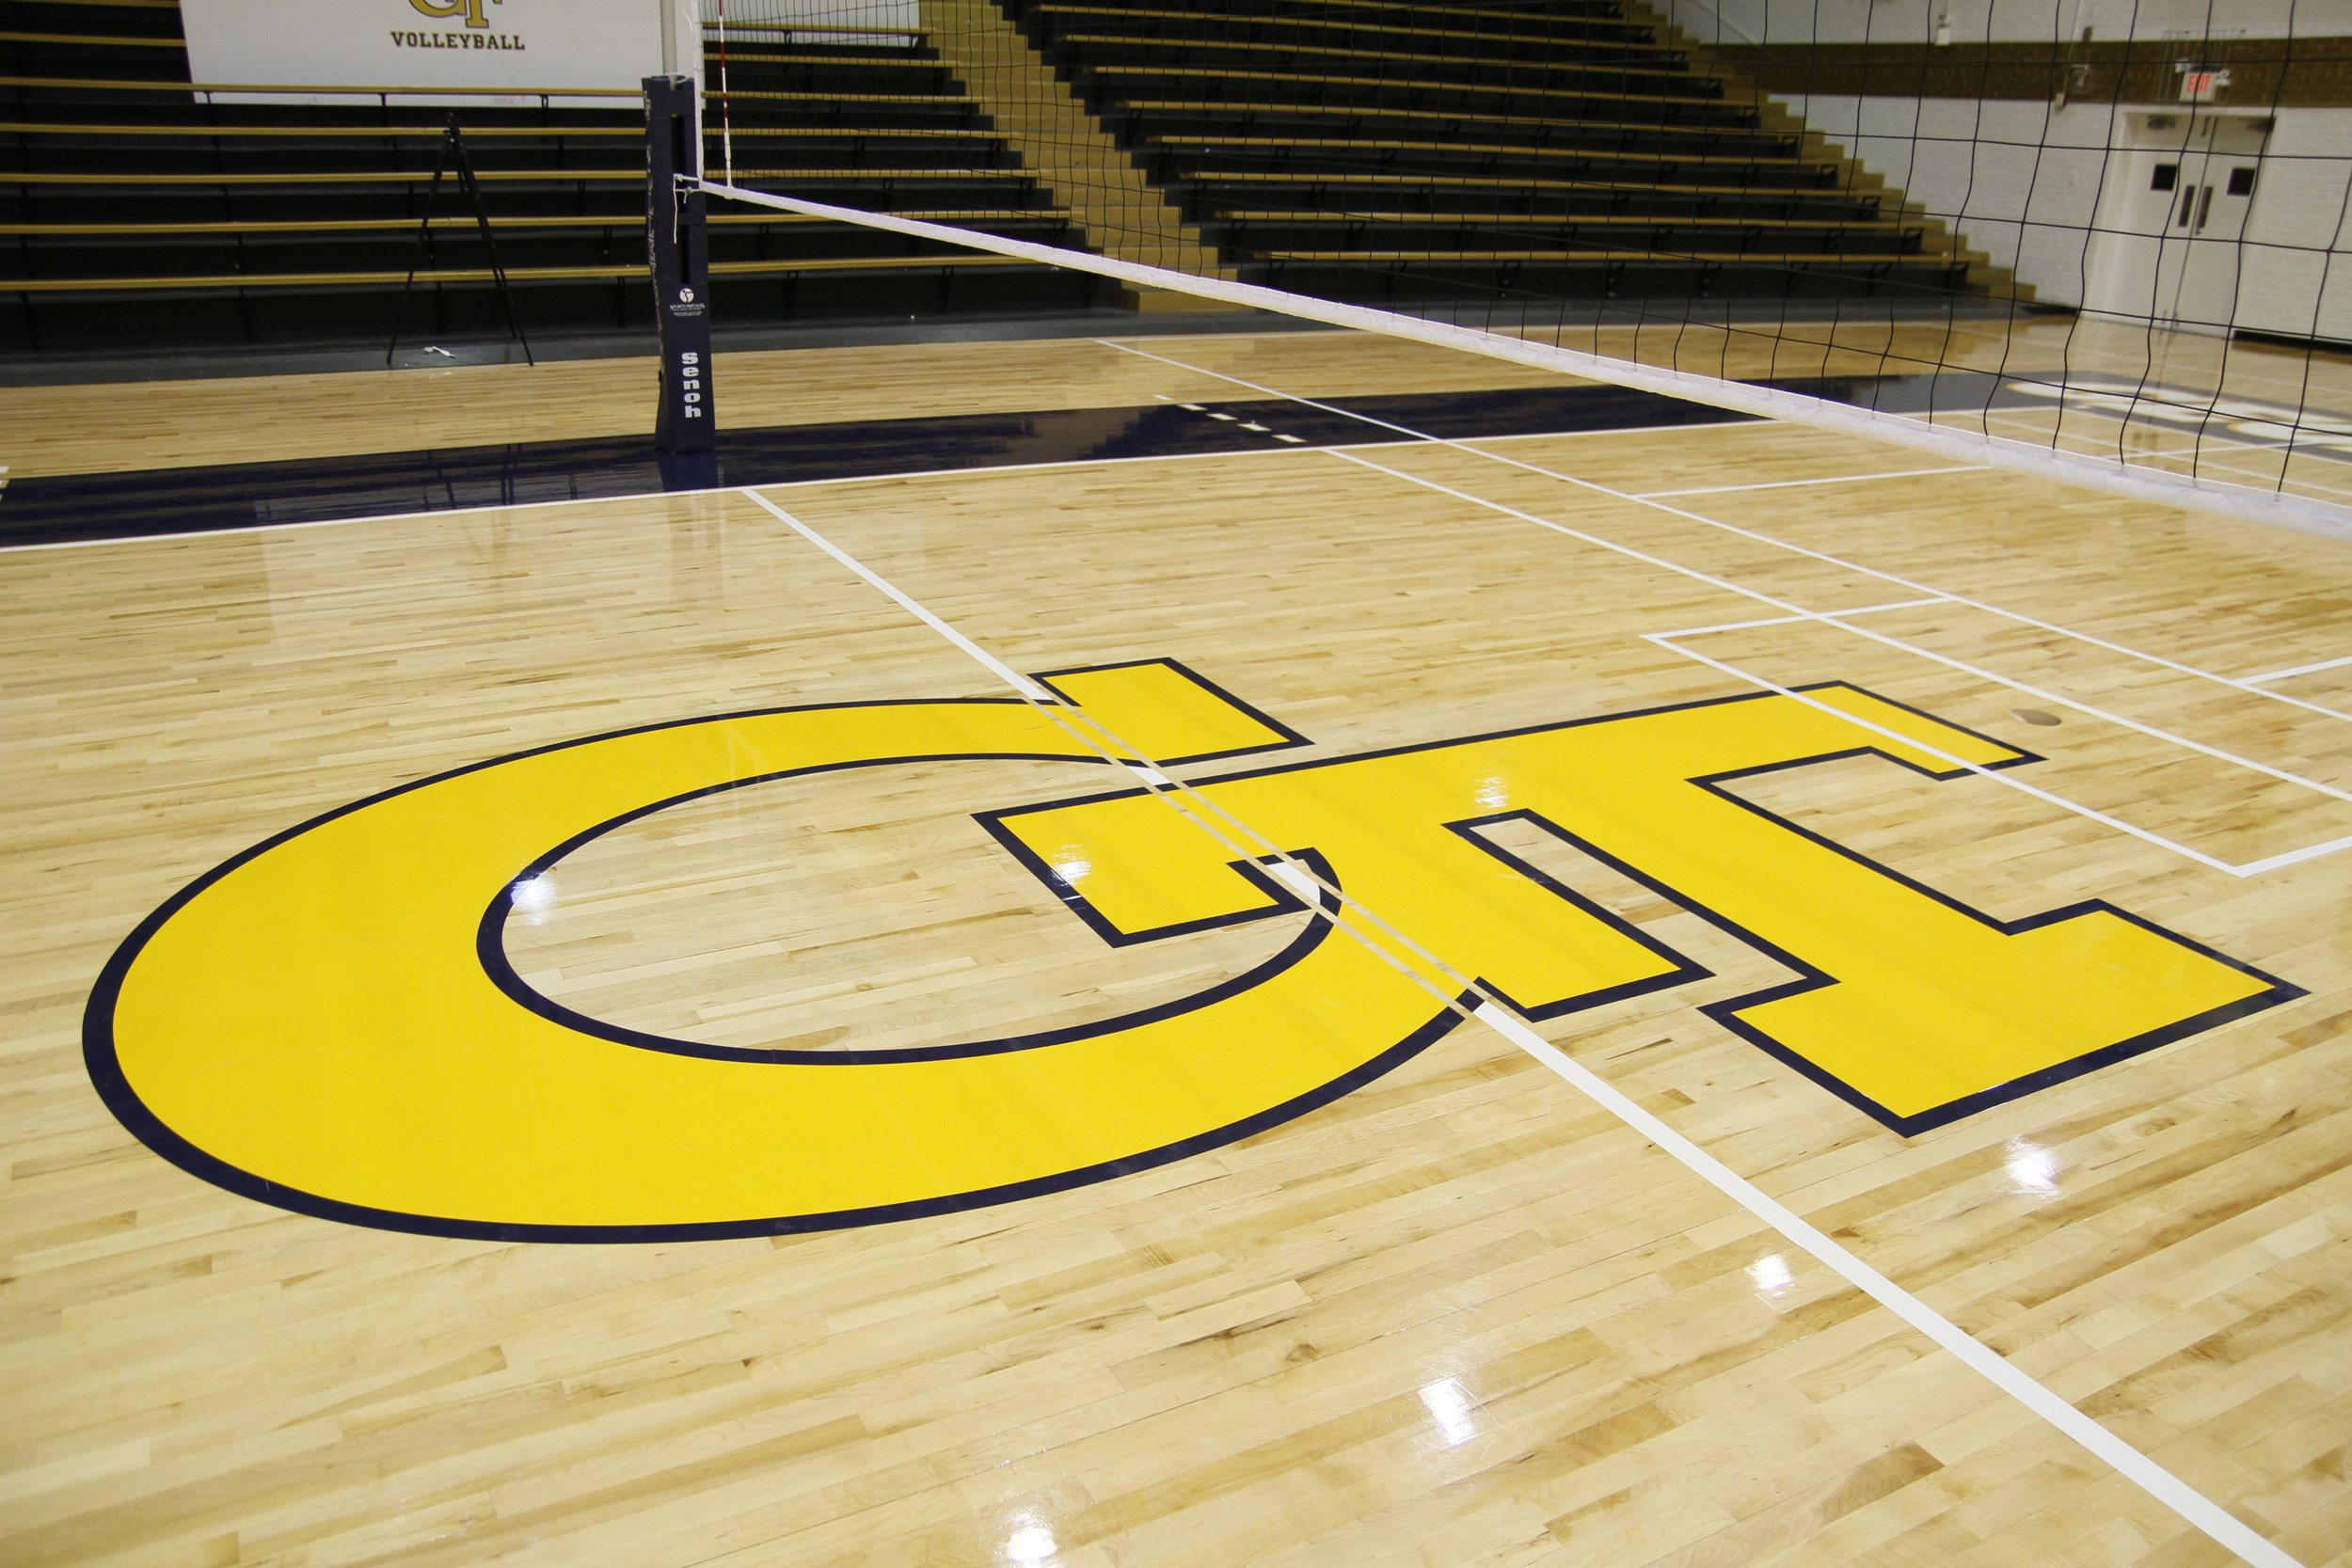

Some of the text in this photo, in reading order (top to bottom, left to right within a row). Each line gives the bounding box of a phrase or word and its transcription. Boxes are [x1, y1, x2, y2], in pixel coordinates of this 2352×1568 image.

[390, 31, 526, 50] VOLLEYBALL
[681, 351, 702, 419] senoh
[82, 657, 2312, 1243] GT
